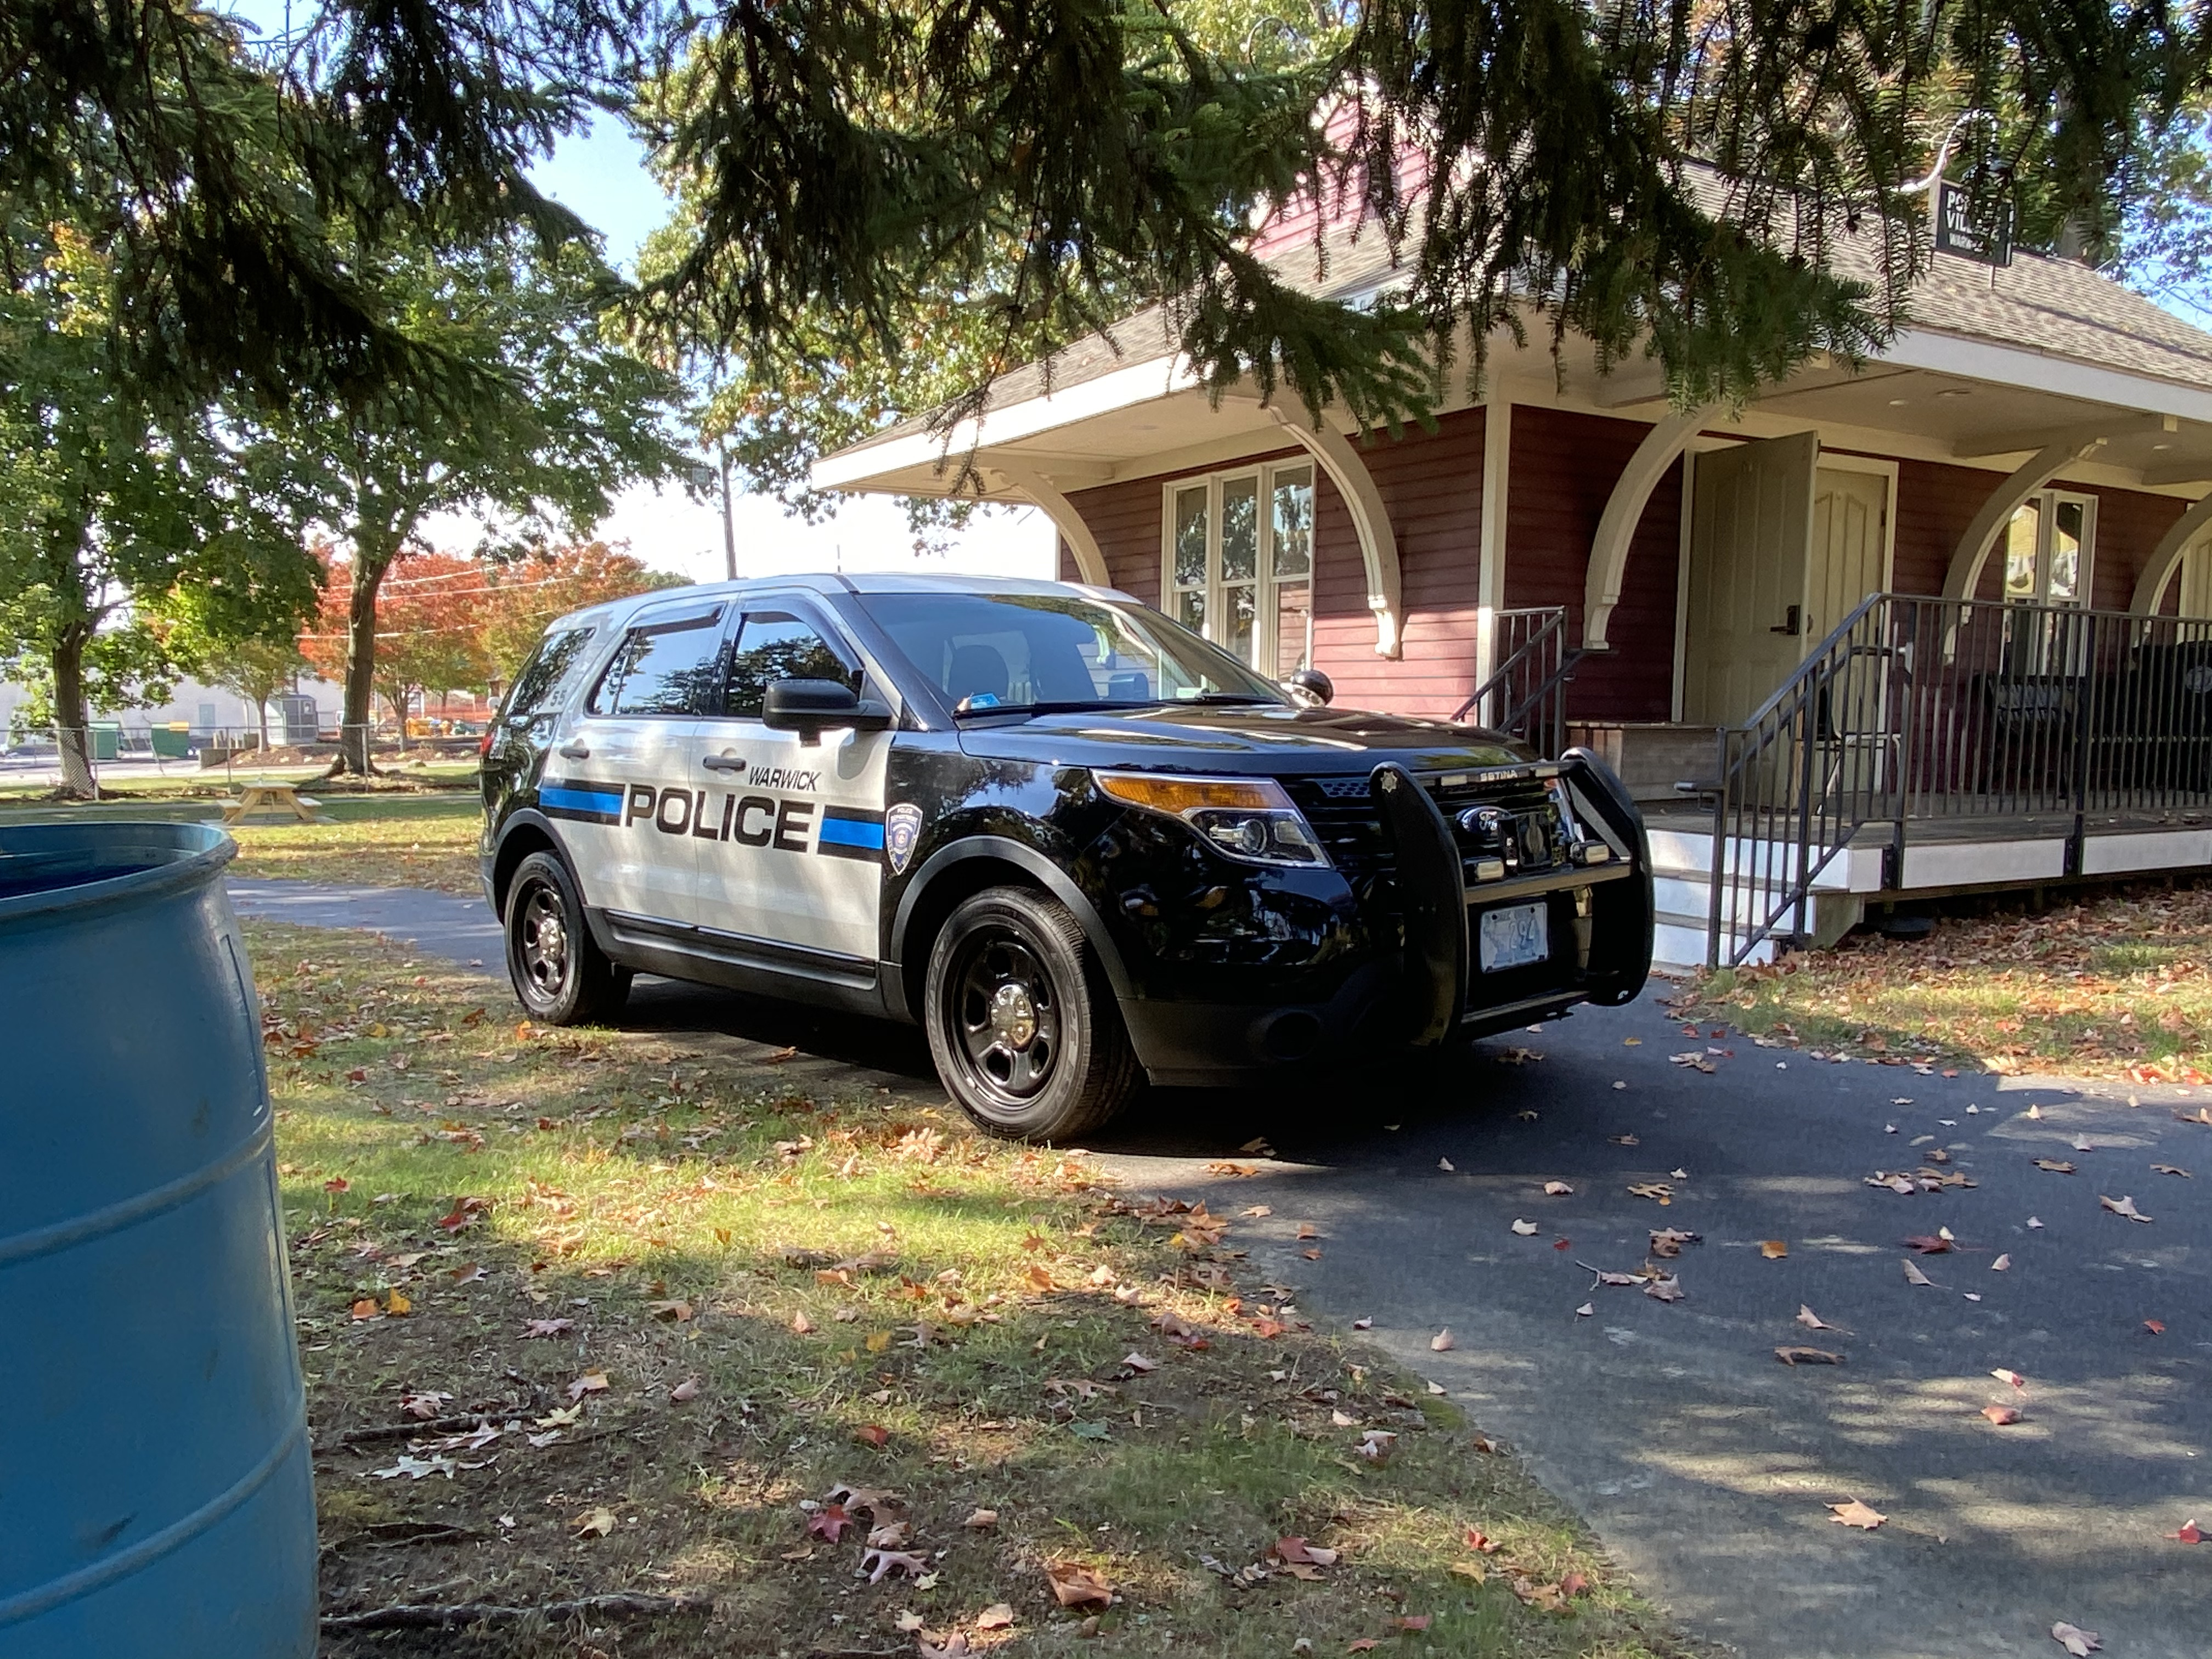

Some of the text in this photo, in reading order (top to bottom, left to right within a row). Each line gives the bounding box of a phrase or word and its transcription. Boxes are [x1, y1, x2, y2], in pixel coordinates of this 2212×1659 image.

[550, 689, 567, 707] 55
[748, 766, 822, 791] WARWICK
[625, 783, 815, 853] POLICE
